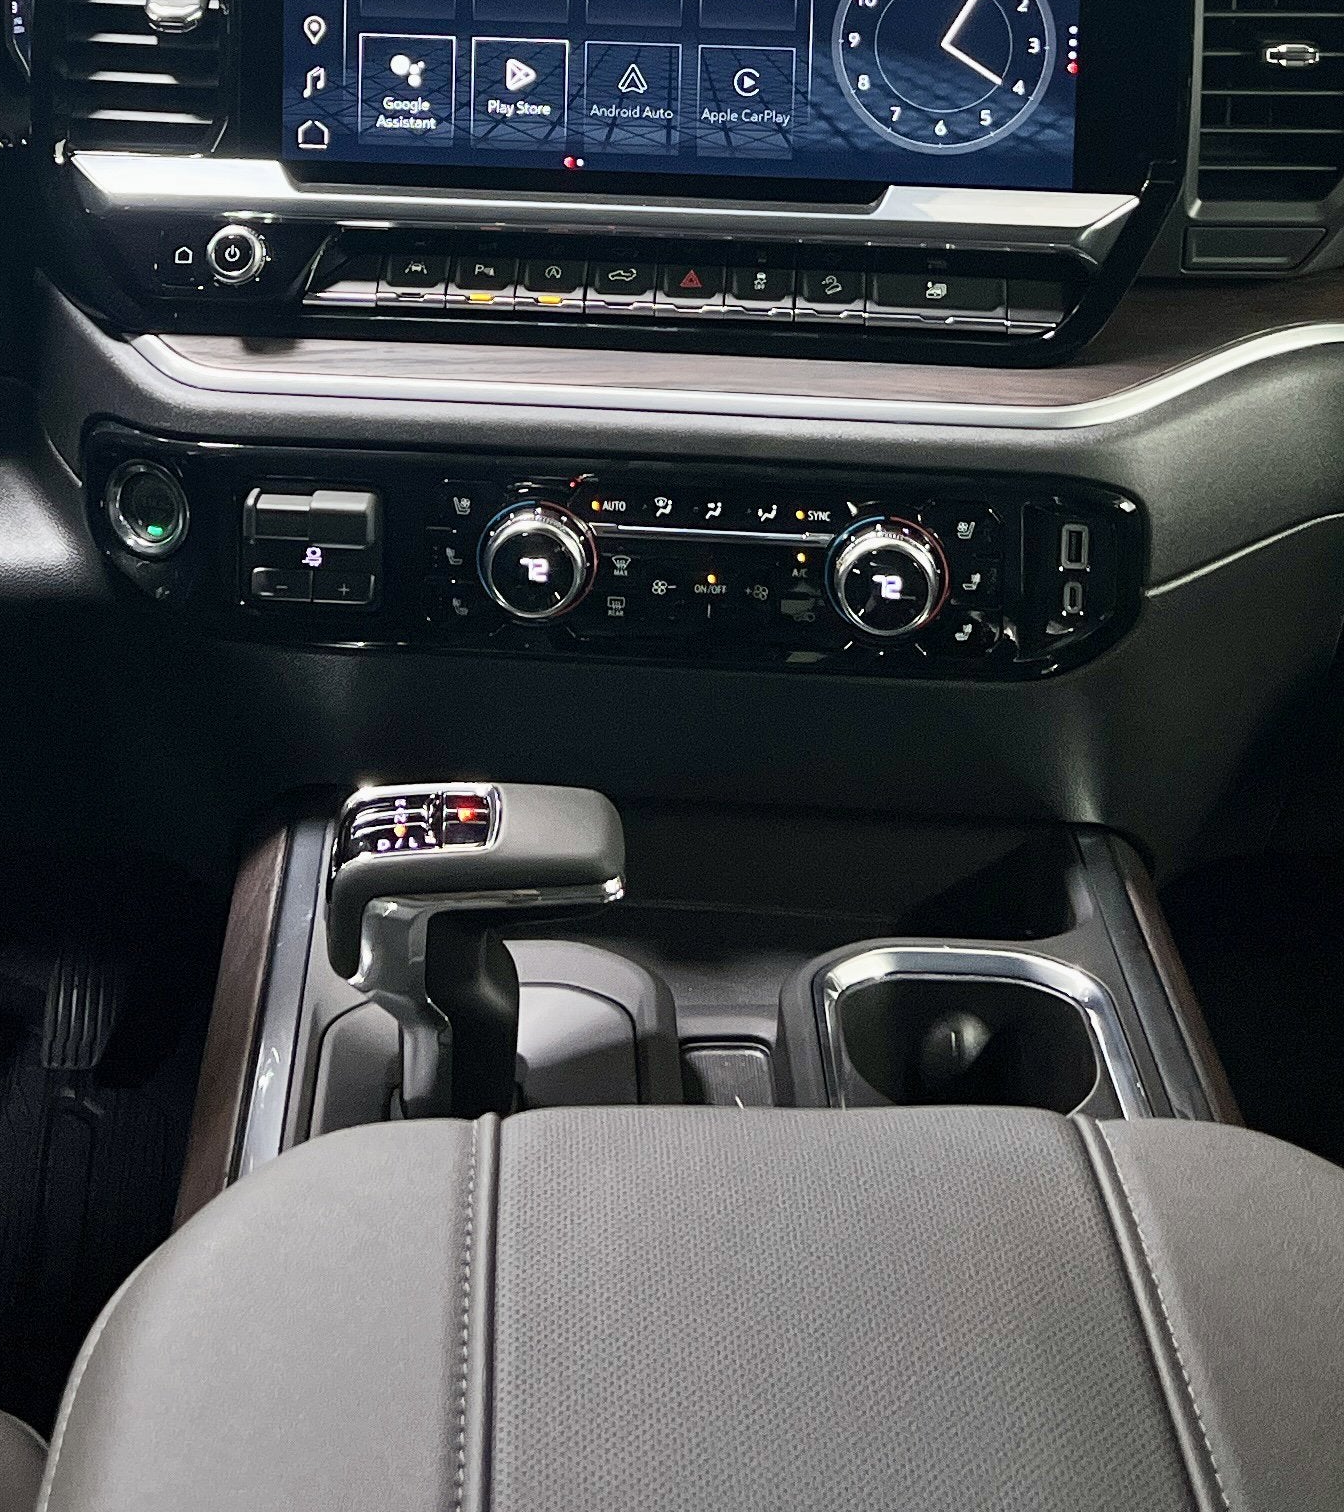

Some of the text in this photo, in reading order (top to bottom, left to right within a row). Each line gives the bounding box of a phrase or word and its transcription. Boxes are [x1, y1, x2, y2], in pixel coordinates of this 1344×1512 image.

[848, 32, 861, 48] 9
[1028, 37, 1041, 54] 3
[857, 74, 871, 90] 8
[1012, 79, 1026, 95] 4
[382, 96, 431, 114] Google
[487, 100, 552, 117] Play Store
[590, 104, 675, 119] Android Auto
[701, 109, 791, 126] Apple CarPlay
[889, 106, 902, 122] 7
[979, 109, 993, 126] 5
[375, 114, 437, 131] Assistant
[934, 119, 948, 136] 6
[602, 500, 626, 512] AUTO
[807, 510, 831, 522] SYNC
[519, 557, 550, 583] 72
[613, 568, 628, 576] MAX
[791, 568, 809, 578] A/C
[694, 584, 727, 594] ON/OFF
[871, 574, 903, 600] 72
